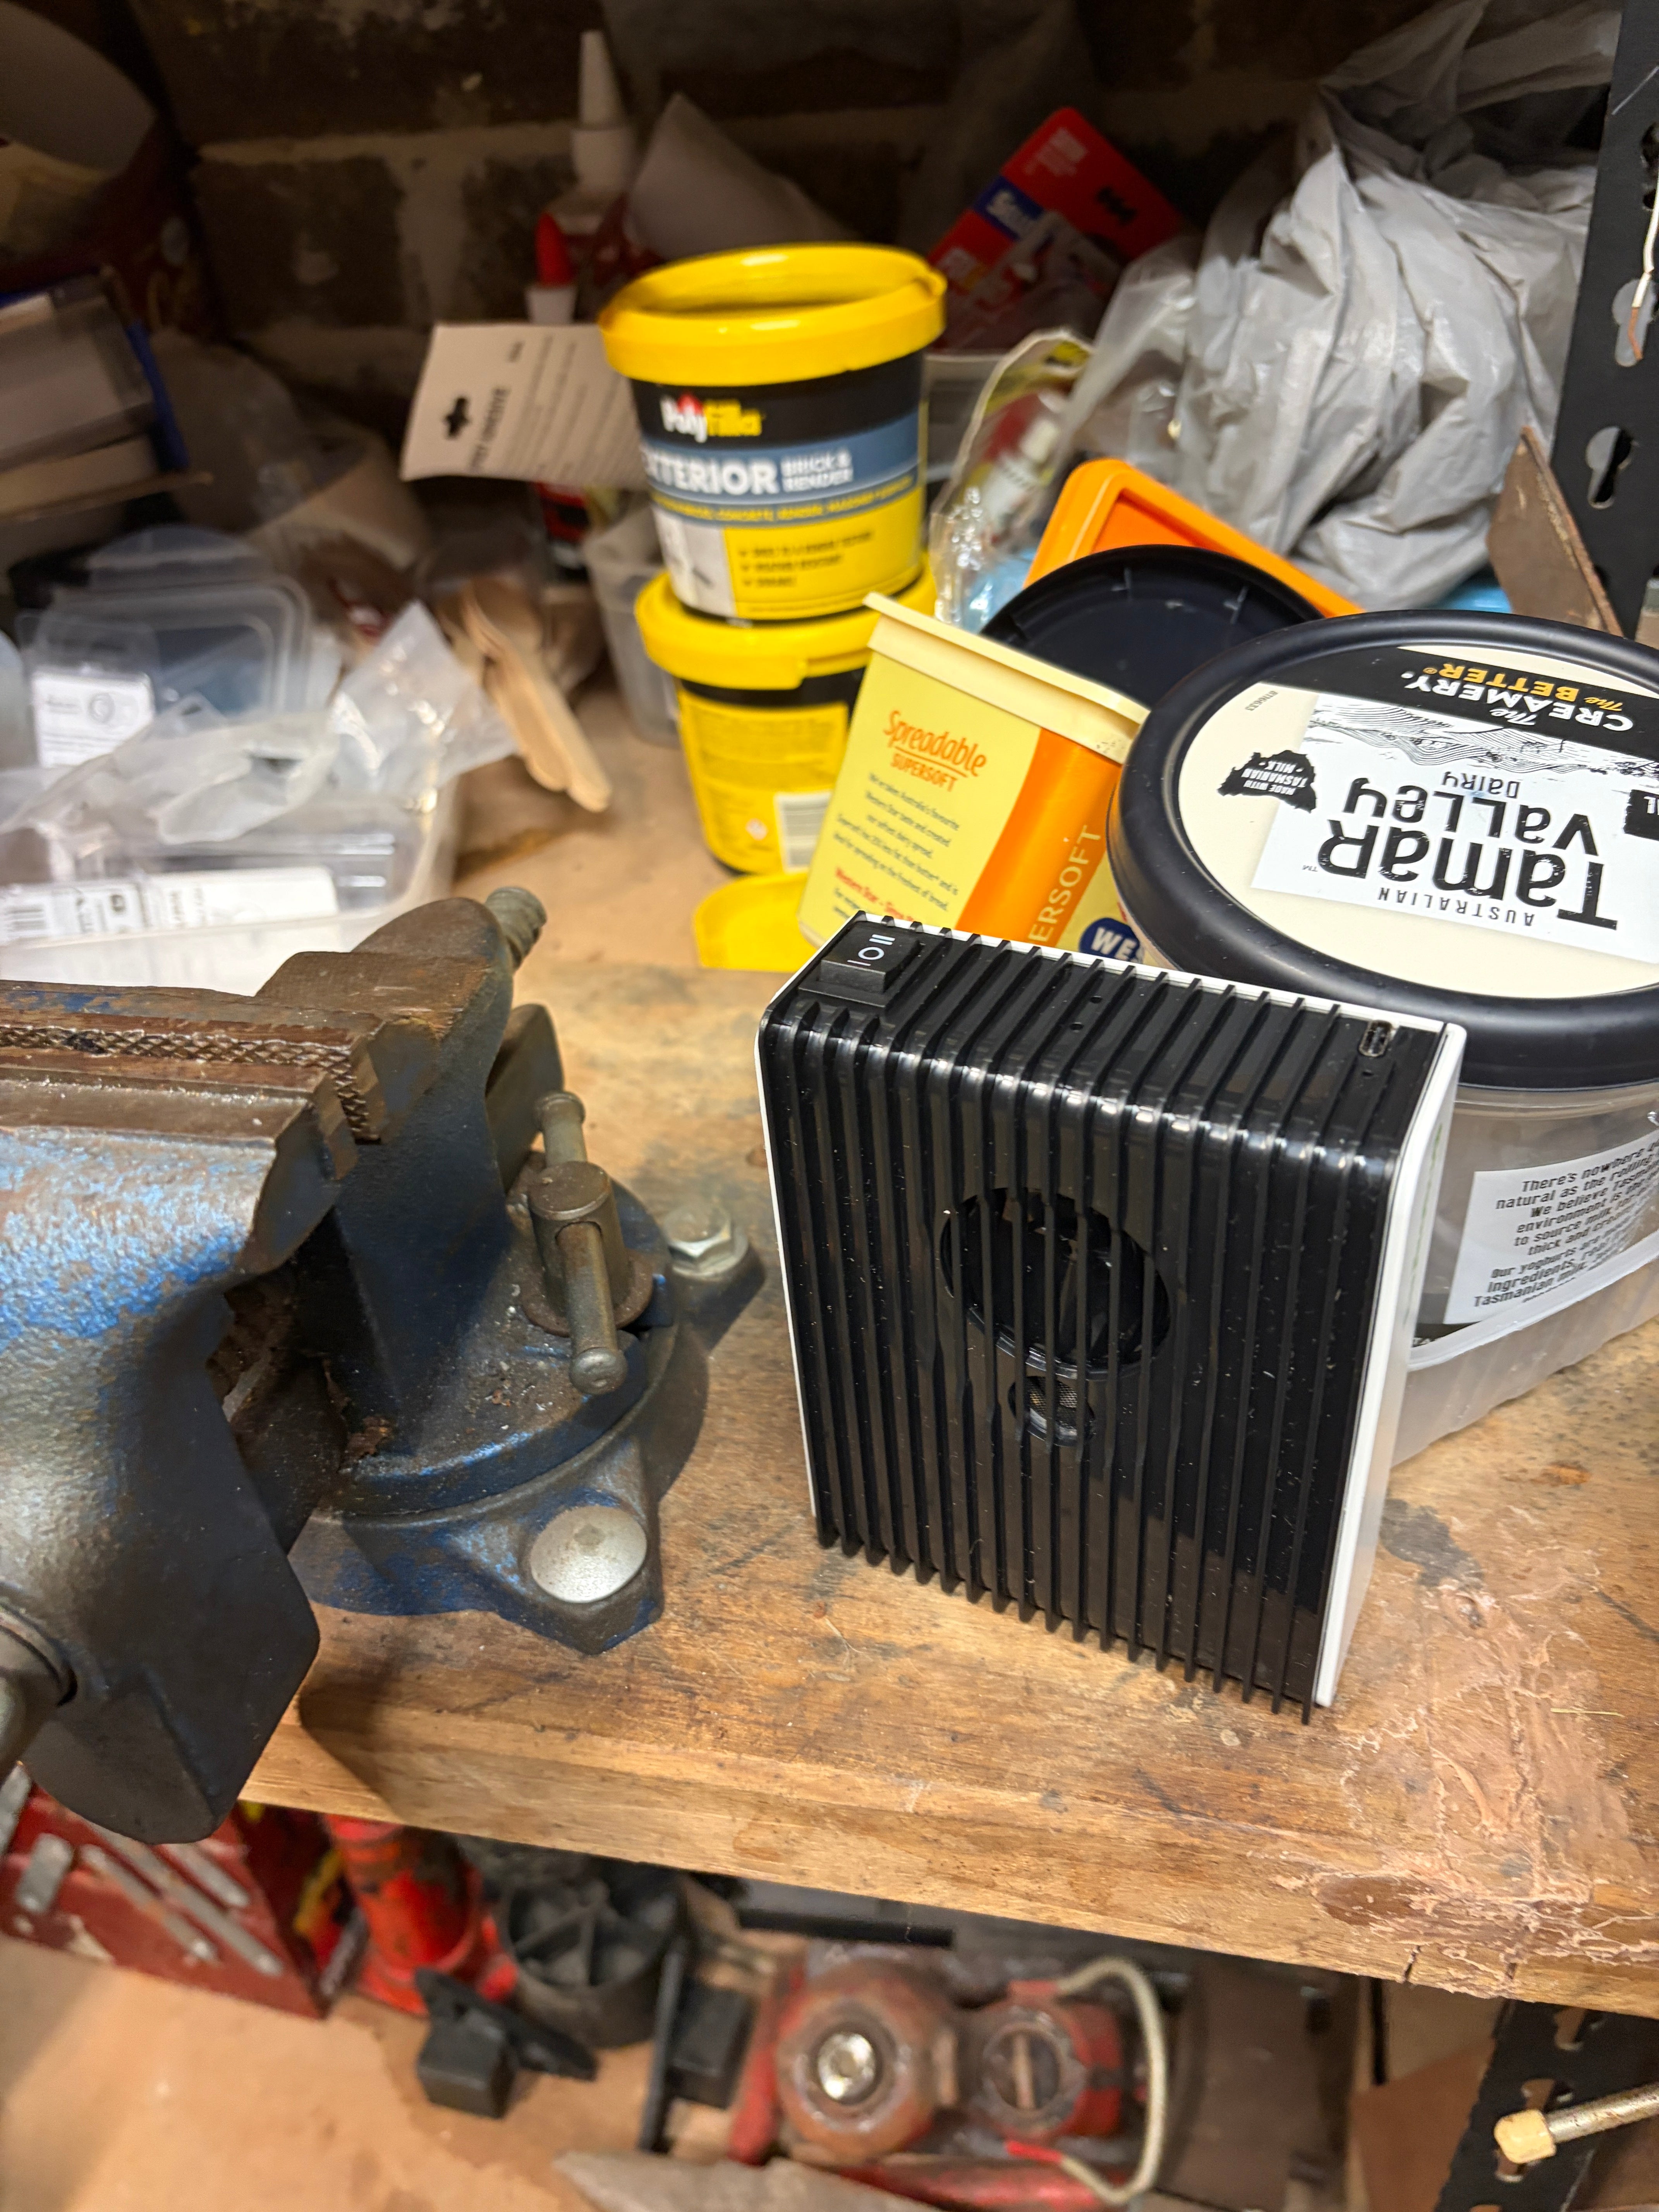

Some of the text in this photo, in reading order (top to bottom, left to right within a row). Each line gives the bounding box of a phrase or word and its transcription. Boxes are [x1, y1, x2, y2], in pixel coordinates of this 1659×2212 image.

[1584, 696, 1623, 711] The
[1490, 707, 1539, 726] The
[883, 710, 987, 777] Spreadable
[890, 753, 958, 792] SUPERSOFT
[1241, 768, 1308, 788] TASMANIAN
[1264, 761, 1297, 773] MILK
[1243, 780, 1296, 795] MADE WITH
[1027, 824, 1101, 942] ERSOFT
[1378, 887, 1535, 927] AUSTRALIAN
[1522, 1173, 1577, 1192] There's
[1496, 1190, 1556, 1209] natural
[1560, 1186, 1578, 1198] as
[1516, 1199, 1607, 1233] environment
[1530, 1206, 1552, 1218] We
[1514, 1236, 1529, 1246] to
[1533, 1221, 1582, 1242] source
[1474, 1278, 1555, 1307] Tasmanian
